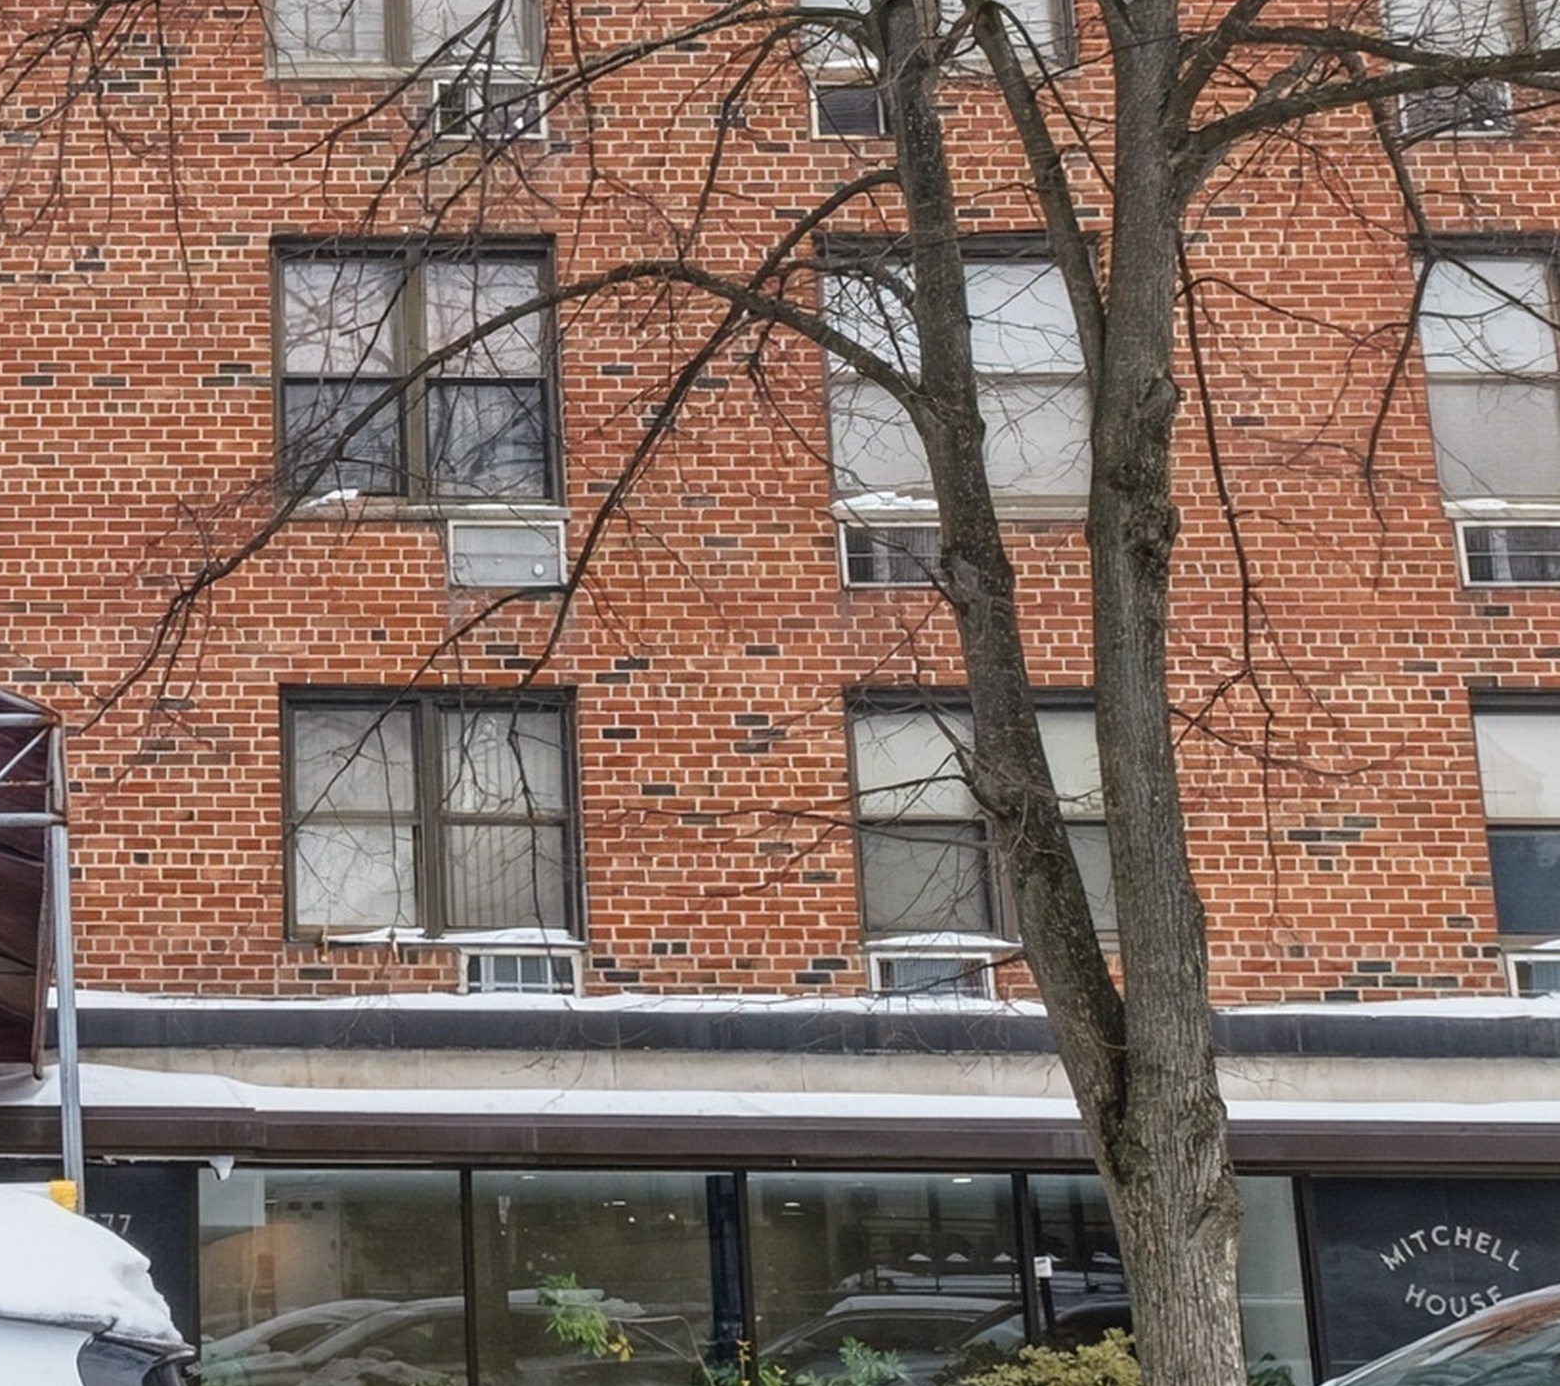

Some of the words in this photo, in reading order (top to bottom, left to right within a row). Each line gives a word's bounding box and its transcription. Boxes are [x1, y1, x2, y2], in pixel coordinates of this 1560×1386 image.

[87, 1214, 132, 1235] 77
[1380, 1225, 1521, 1272] MITCHELL
[1405, 1283, 1502, 1318] HOUSE
